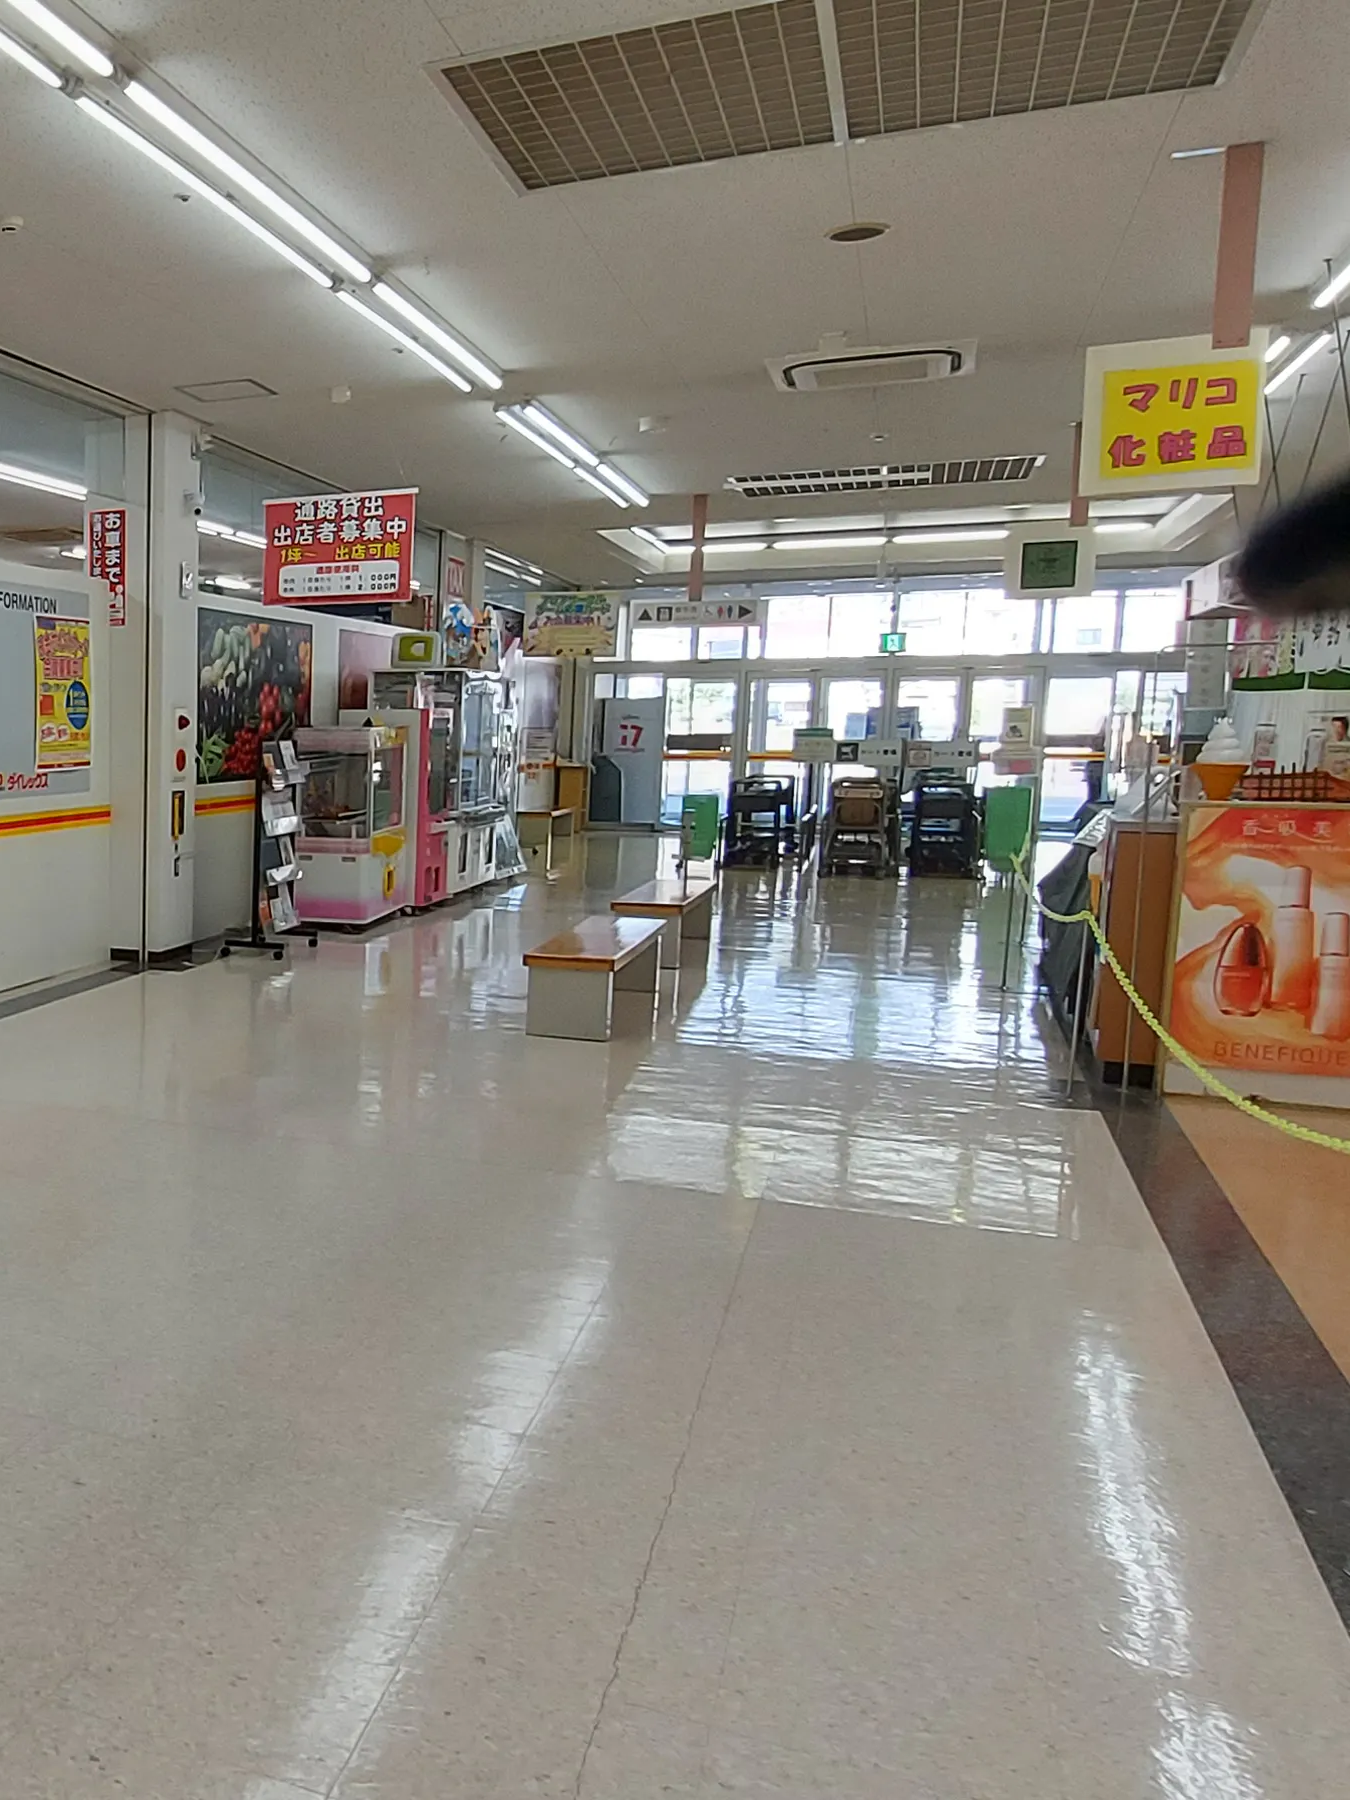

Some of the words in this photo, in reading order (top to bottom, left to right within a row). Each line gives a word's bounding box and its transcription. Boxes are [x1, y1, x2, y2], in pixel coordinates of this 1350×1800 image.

[1123, 377, 1238, 413] マリコ
[1107, 425, 1247, 469] 化粧品
[294, 496, 385, 522] 通路貸出
[272, 516, 408, 548] 出店者募集中
[334, 541, 401, 561] 出店可能
[8, 773, 49, 791] ダイレックス
